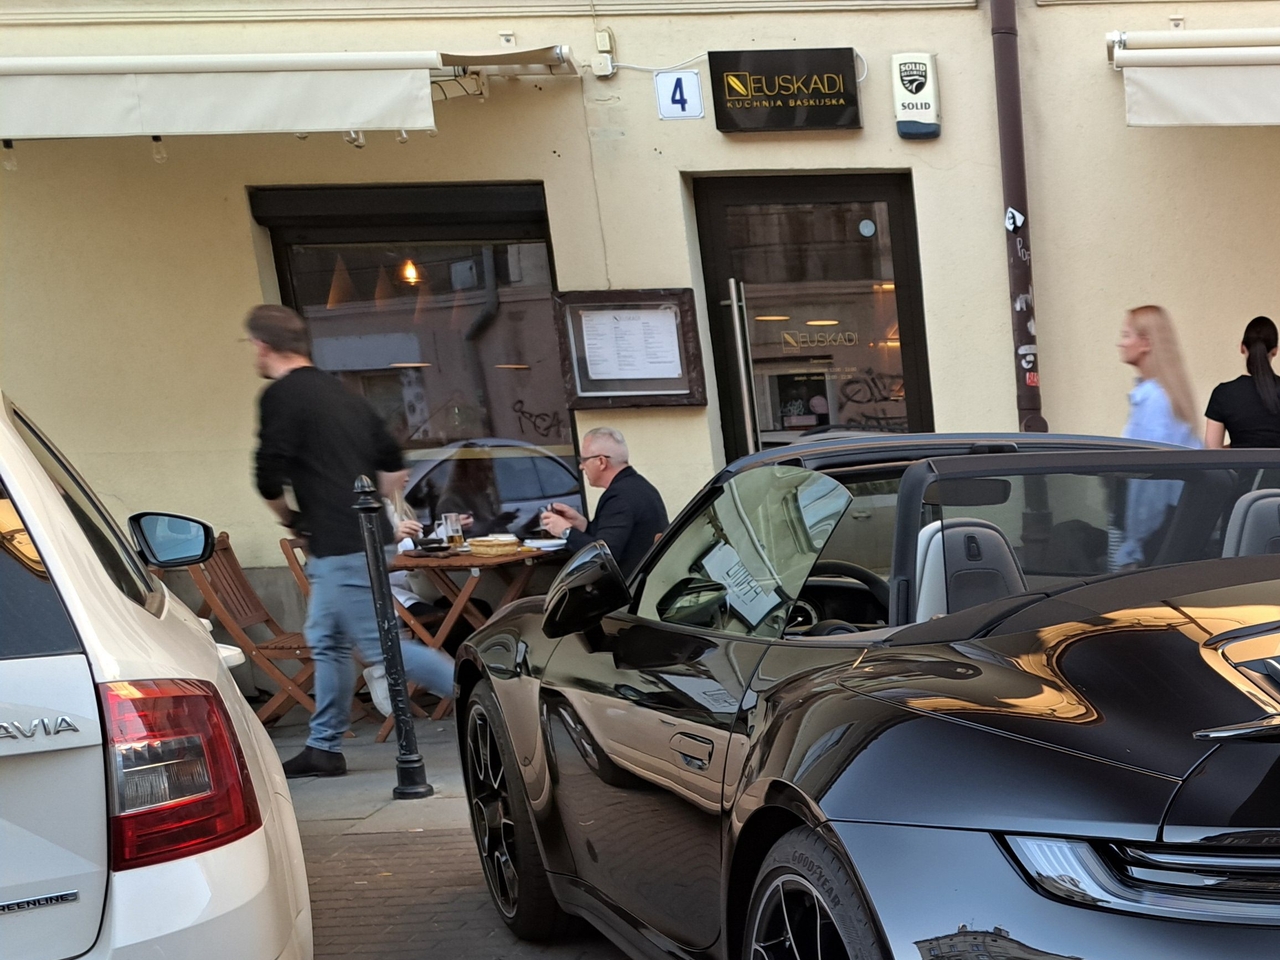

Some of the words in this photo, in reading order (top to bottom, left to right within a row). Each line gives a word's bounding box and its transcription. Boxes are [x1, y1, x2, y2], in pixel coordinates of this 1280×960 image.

[900, 63, 927, 72] SOLID
[670, 76, 689, 113] 4
[726, 99, 784, 109] KUCHNIA
[788, 97, 846, 108] BASKIJSKA
[901, 101, 931, 111] SOLID
[0, 715, 80, 740] AVIA
[791, 849, 843, 909] GOODYEAR
